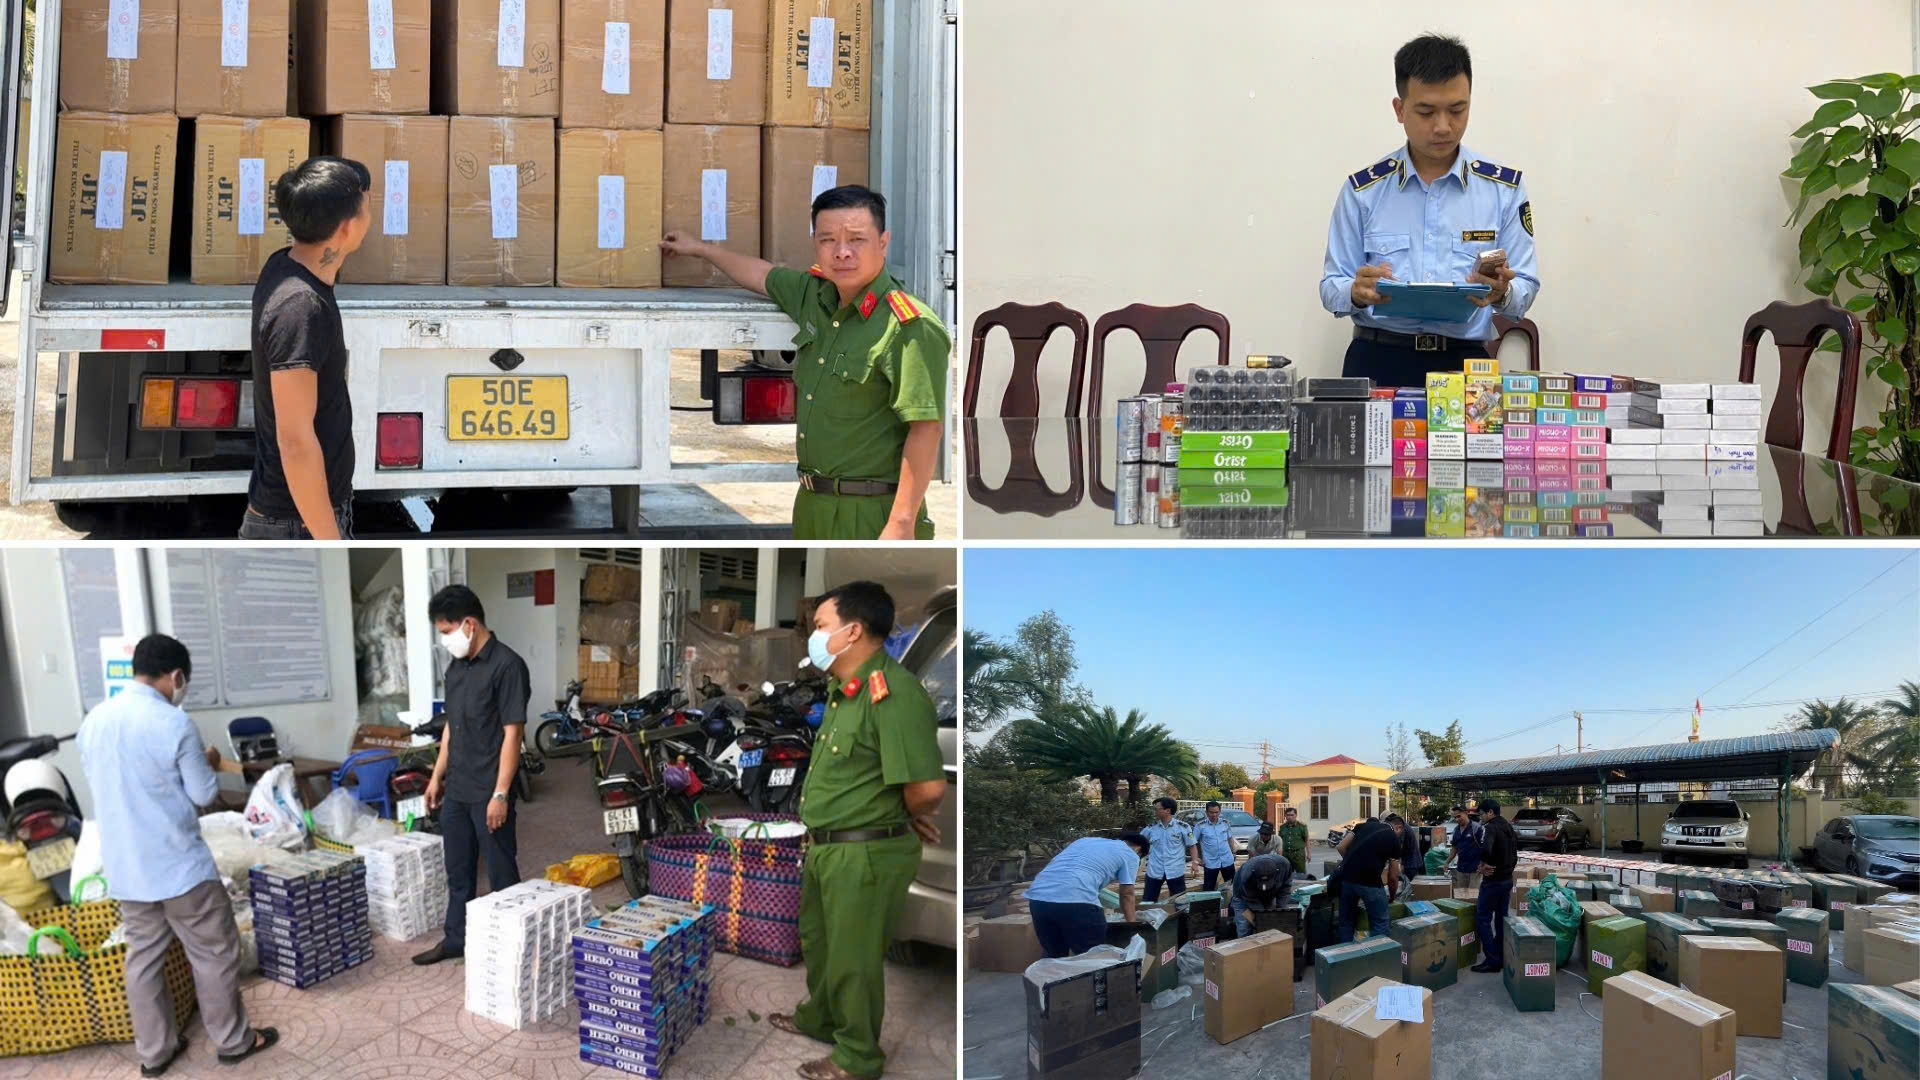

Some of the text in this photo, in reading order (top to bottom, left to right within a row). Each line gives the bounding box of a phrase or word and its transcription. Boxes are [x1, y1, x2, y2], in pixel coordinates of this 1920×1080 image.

[796, 30, 810, 70] JET
[838, 31, 850, 72] JET
[80, 173, 98, 220] JET
[132, 176, 148, 222] JET
[148, 227, 156, 255] FILTER
[152, 145, 160, 196] CIGARETTES
[218, 176, 232, 221] JET
[66, 200, 76, 252] CIGARETTES
[206, 202, 214, 254] CIGARETTES
[483, 380, 533, 405] 50E
[462, 410, 555, 435] 646.49
[584, 953, 614, 966] HERO
[608, 946, 638, 960] HERO
[609, 972, 638, 986] HERO
[610, 985, 641, 998] HERO
[588, 1002, 618, 1017] HERO
[610, 997, 640, 1012] HERO
[590, 1028, 619, 1044] HERO
[616, 1022, 645, 1037] HERO
[614, 1046, 644, 1062] HERO
[616, 1060, 646, 1076] HERO
